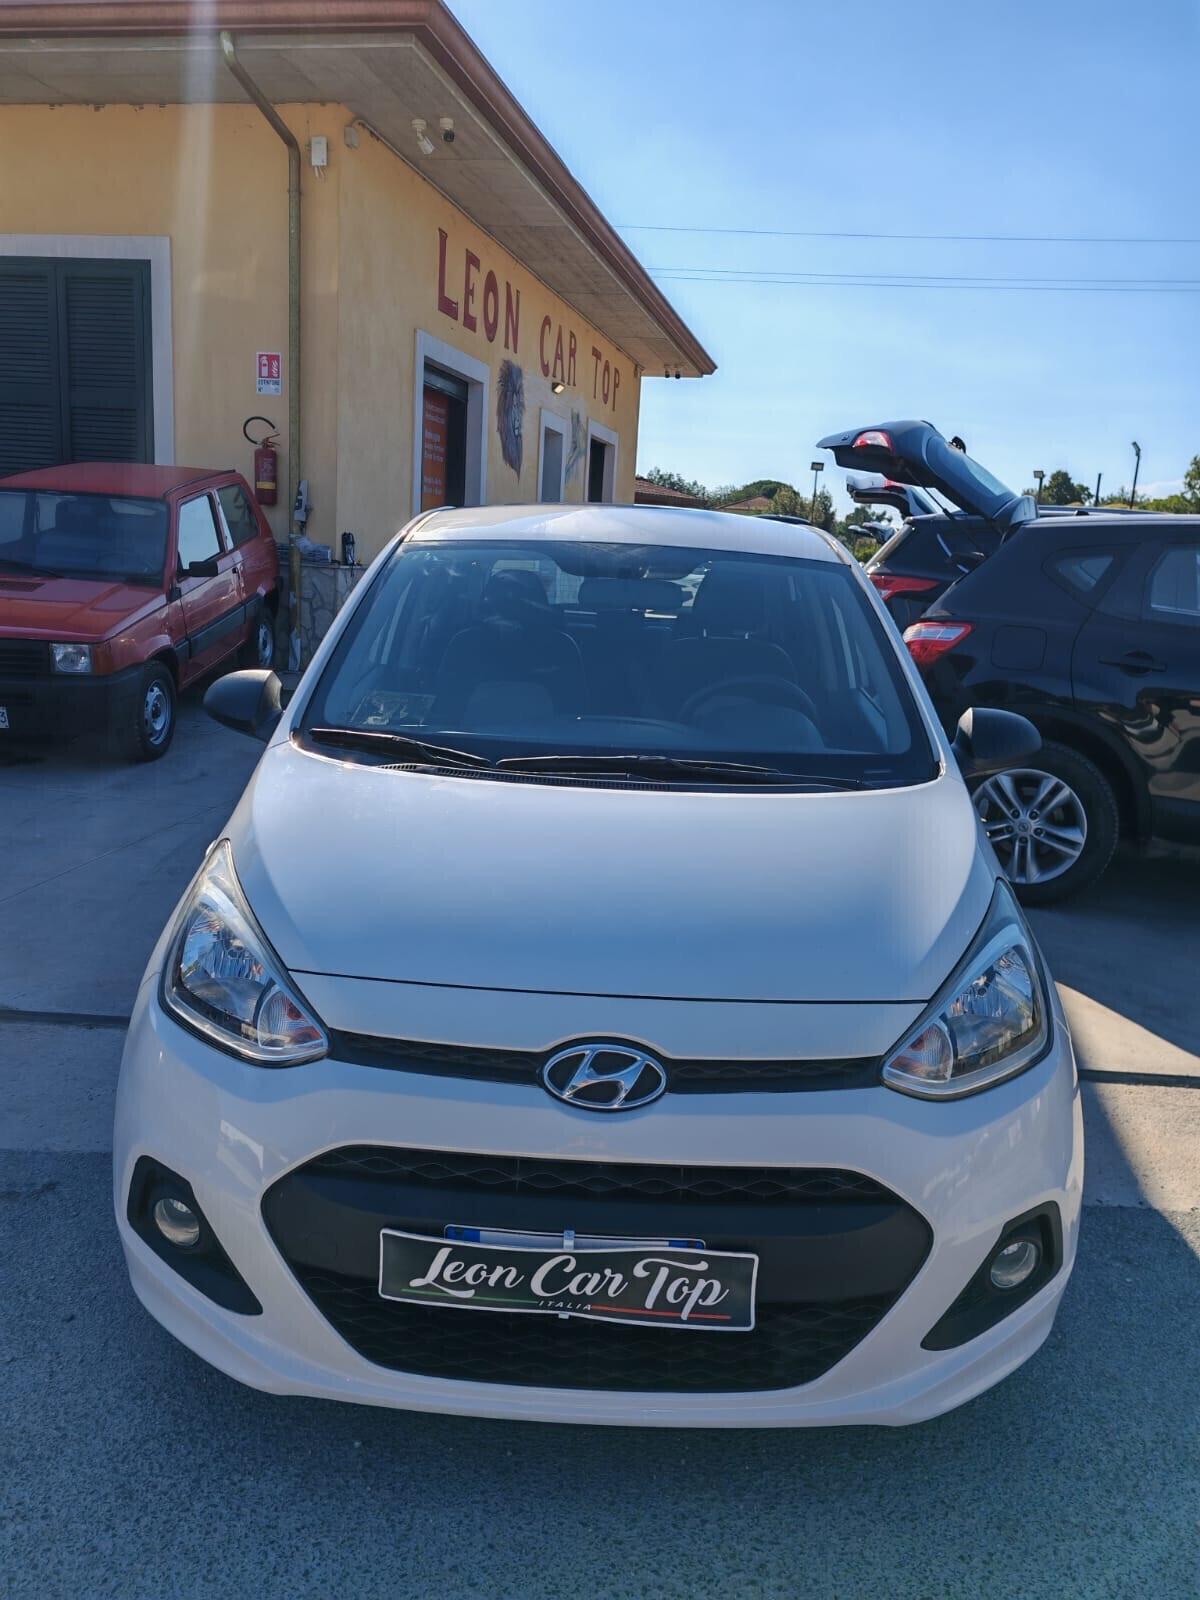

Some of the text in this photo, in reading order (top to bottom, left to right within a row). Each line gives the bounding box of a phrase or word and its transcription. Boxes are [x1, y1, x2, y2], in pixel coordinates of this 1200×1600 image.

[438, 227, 620, 412] LEON CAR TOP
[409, 1247, 730, 1320] Leon Car Top
[538, 1300, 592, 1311] ITALIA
